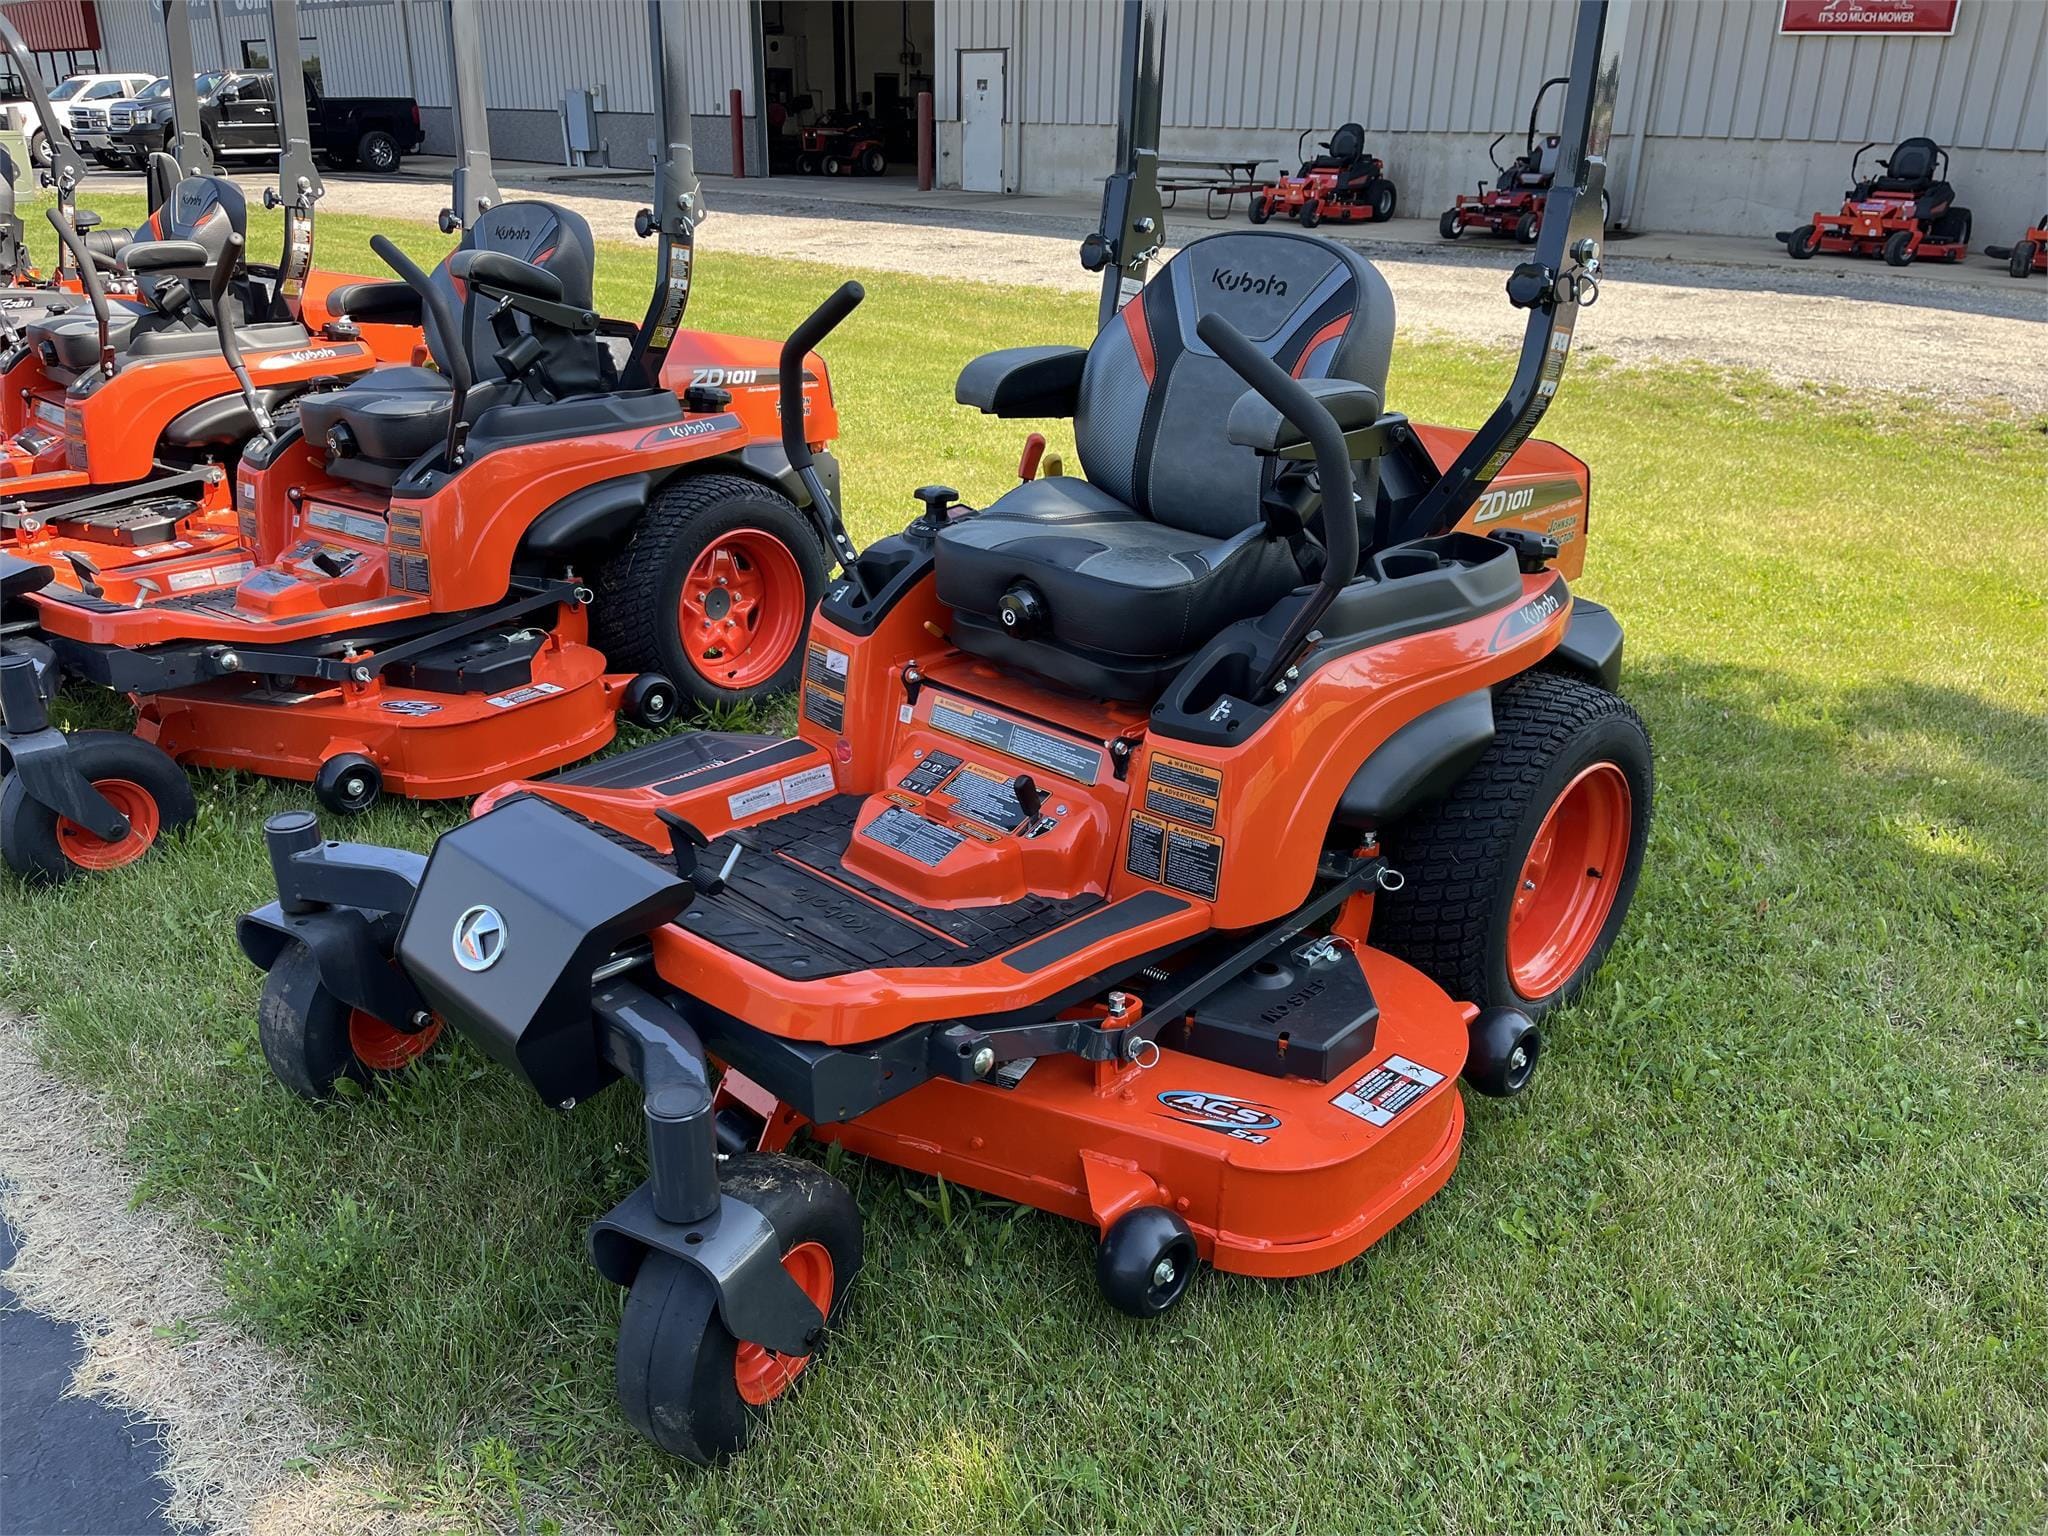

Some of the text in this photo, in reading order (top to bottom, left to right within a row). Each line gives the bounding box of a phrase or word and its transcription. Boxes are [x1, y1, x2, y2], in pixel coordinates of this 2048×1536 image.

[1818, 12, 1914, 23] IT'S SO MUCH MOWER
[495, 225, 530, 240] Kubota
[1211, 267, 1288, 297] Kubota
[291, 347, 336, 361] Kubota
[669, 420, 715, 438] Kubota
[1520, 594, 1560, 625] Kubota
[1174, 760, 1205, 774] WARNING
[1164, 788, 1206, 804] ADVERTENCIA
[1181, 827, 1216, 842] ADVERTENCIA
[1261, 979, 1326, 1024] NO STEP
[1173, 1094, 1266, 1124] ACS
[1228, 1128, 1268, 1144] 54
